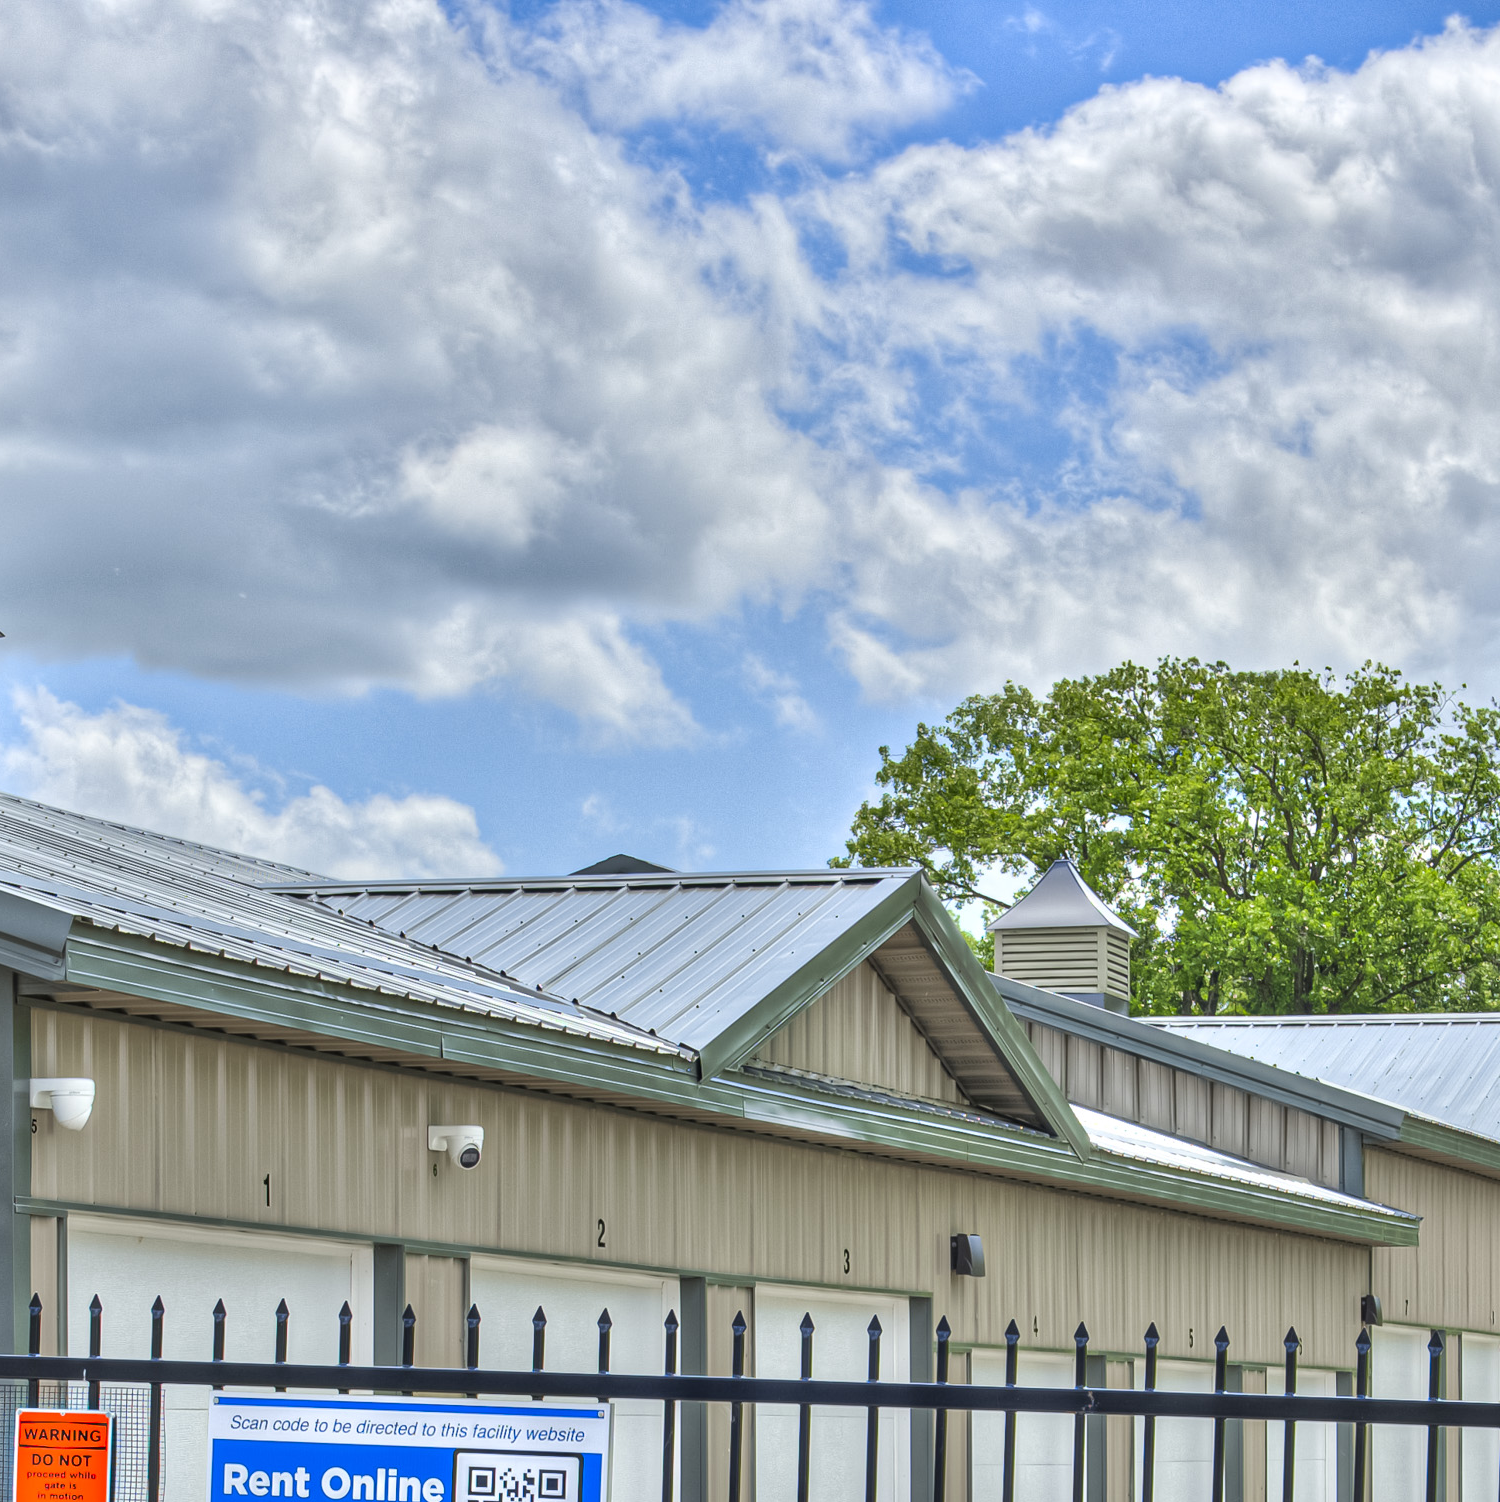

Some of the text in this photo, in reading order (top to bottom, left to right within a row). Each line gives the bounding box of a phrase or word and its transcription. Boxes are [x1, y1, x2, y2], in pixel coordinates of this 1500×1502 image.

[432, 1163, 438, 1177] 6
[263, 1173, 270, 1207] 1
[597, 1218, 606, 1248] 2
[843, 1248, 850, 1275] 3
[24, 1428, 101, 1442] WARNING
[230, 1414, 586, 1444] Scan code to be directed to this facility website
[32, 1453, 92, 1467] DO NOT
[26, 1471, 96, 1480] proceed while
[223, 1463, 310, 1498] Rent
[44, 1482, 77, 1491] gate is
[37, 1492, 84, 1501] in motion
